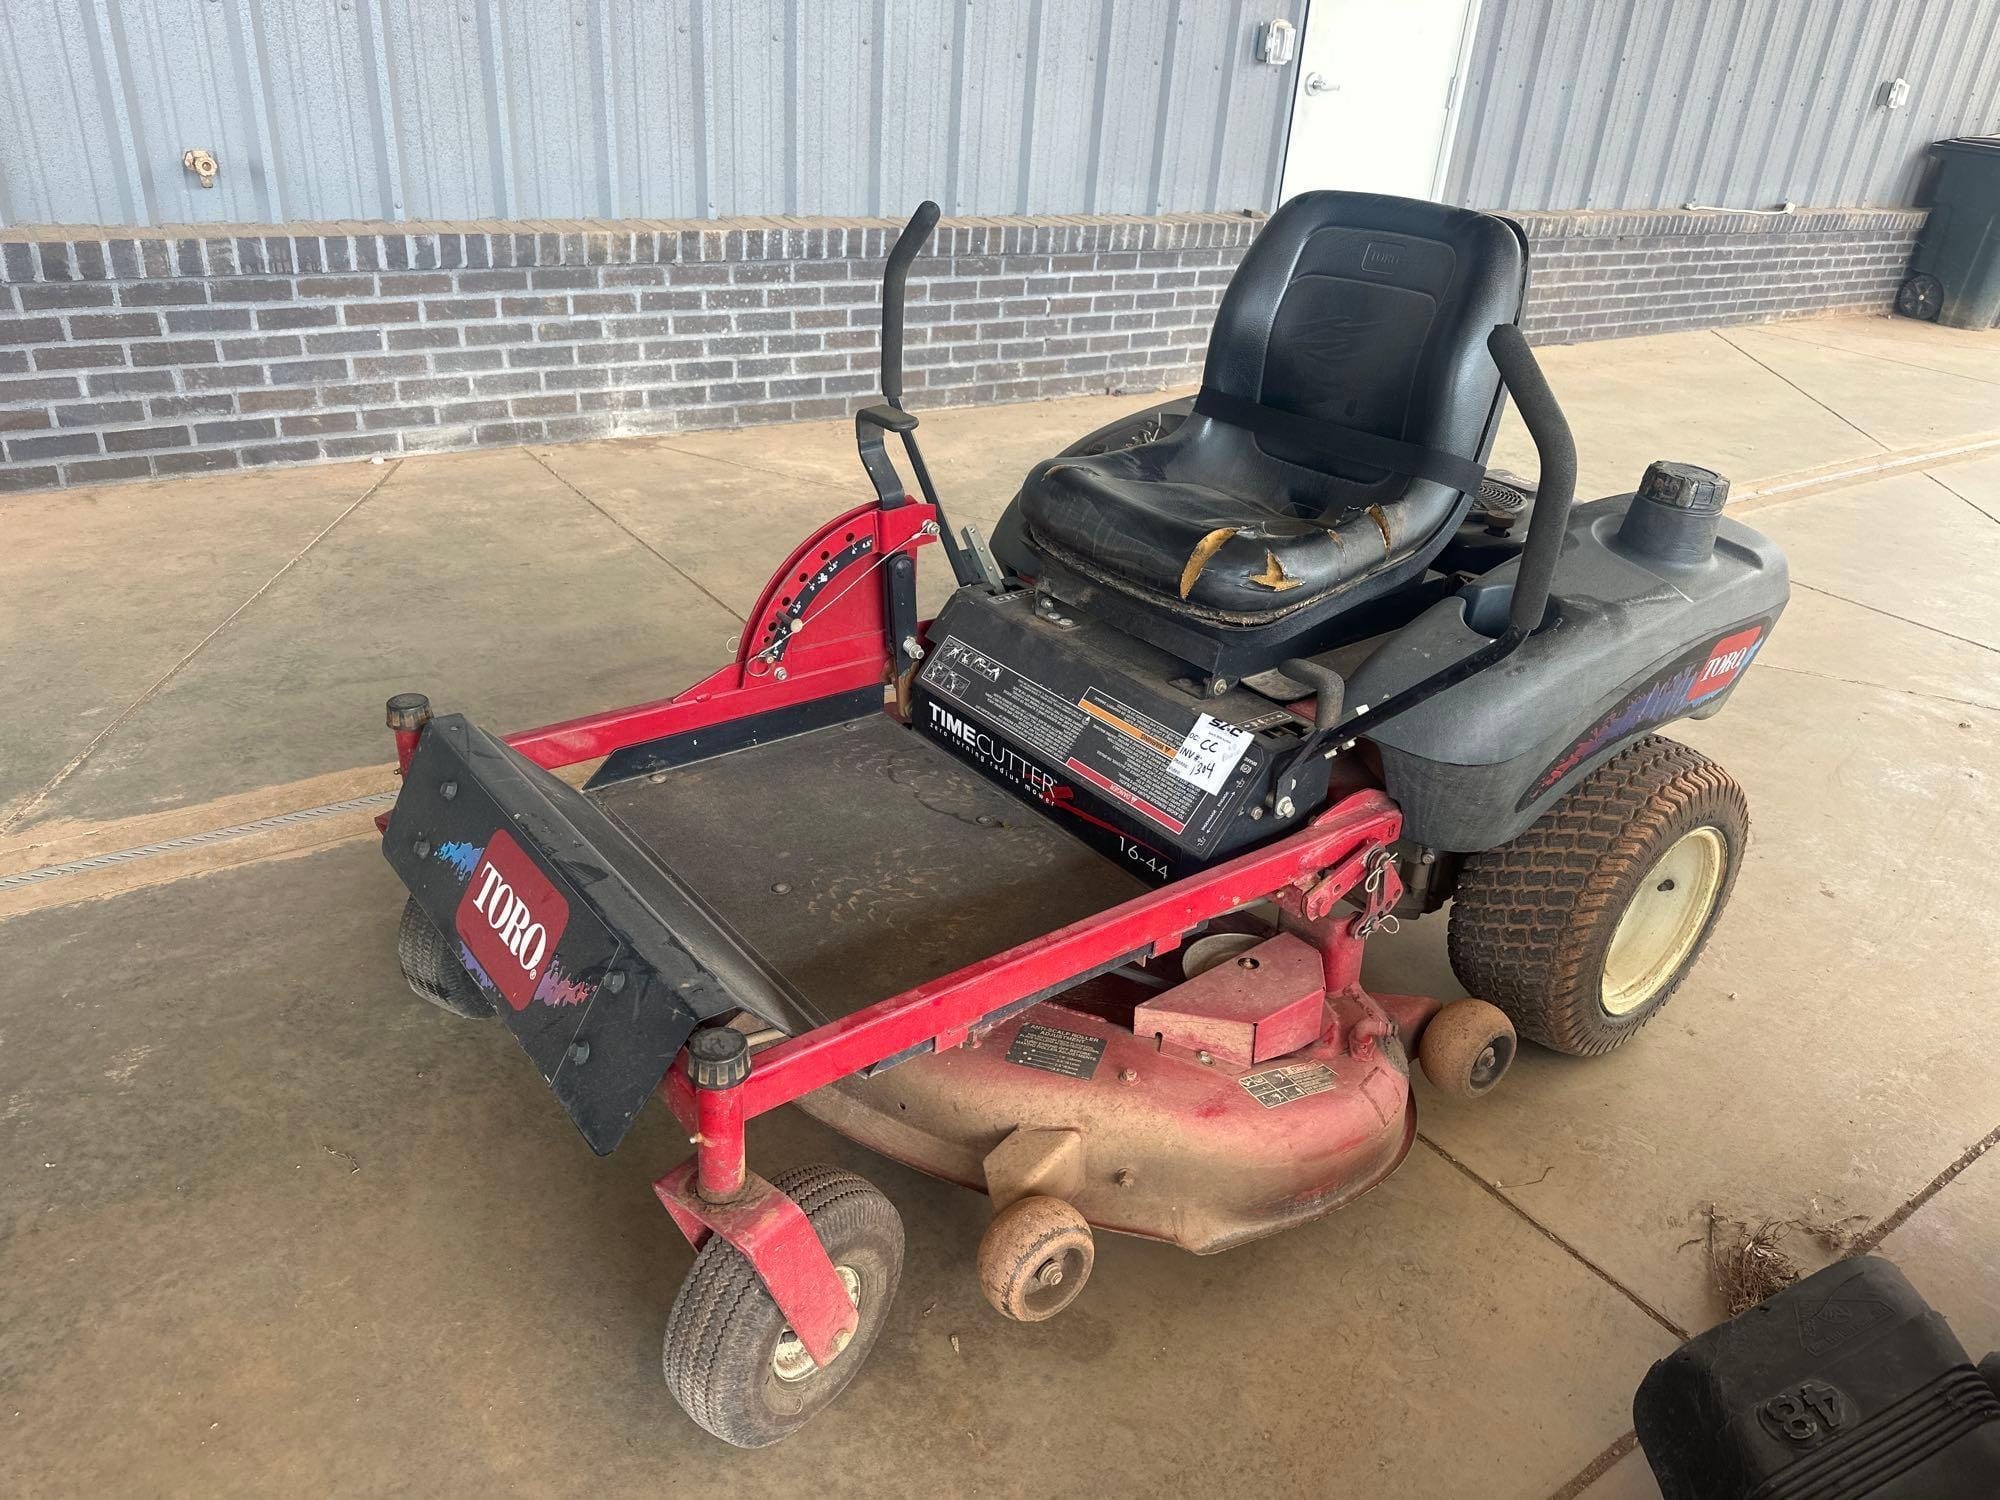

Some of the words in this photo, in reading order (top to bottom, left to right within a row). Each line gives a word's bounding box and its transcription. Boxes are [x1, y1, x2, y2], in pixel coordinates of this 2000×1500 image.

[1700, 647, 1747, 682] TORO
[928, 702, 1055, 798] TIMECUTTER
[930, 722, 948, 737] zero
[952, 735, 985, 763] turning
[990, 760, 1019, 785] radius
[1024, 784, 1055, 807] mower
[1189, 762, 1216, 779] 1304
[1119, 835, 1169, 880] 16-44
[473, 861, 547, 970] TORO
[1764, 1384, 1842, 1440] 48
